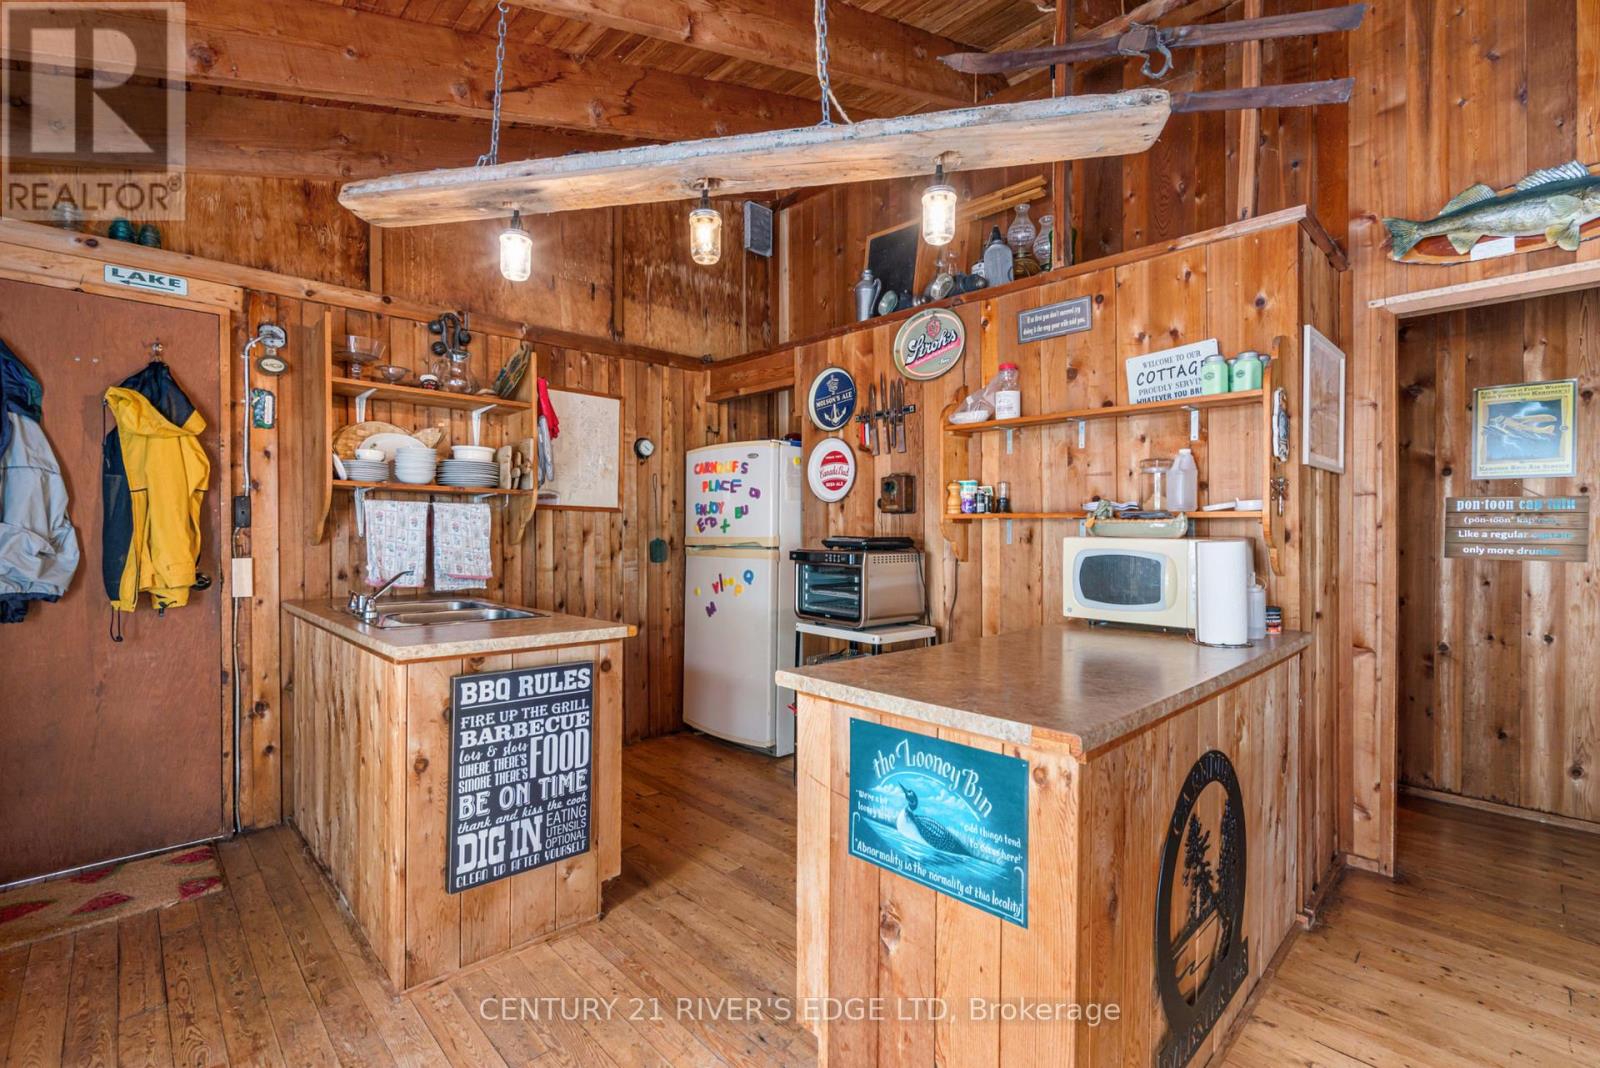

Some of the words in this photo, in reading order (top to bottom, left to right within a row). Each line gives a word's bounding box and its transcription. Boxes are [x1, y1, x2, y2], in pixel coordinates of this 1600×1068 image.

[112, 268, 181, 288] LAKE
[905, 329, 957, 365] Stroh's
[1142, 356, 1173, 368] WELCOME
[1187, 351, 1200, 359] OUR
[816, 395, 841, 408] MOLSON'S
[842, 391, 852, 400] ALE
[1139, 383, 1172, 396] PROUDLY
[1174, 390, 1187, 398] YOU
[702, 478, 742, 493] PLACE
[694, 500, 725, 516] ENJOY
[1458, 529, 1479, 538] Like
[1490, 530, 1529, 541] regular
[1463, 545, 1485, 556] only
[460, 677, 511, 706] BBQ
[518, 668, 591, 698] RULES
[461, 712, 496, 730] FIRE
[500, 709, 519, 723] UP
[521, 704, 548, 720] THE
[551, 698, 590, 714] GRILL
[459, 711, 590, 749] BARBECUE
[487, 745, 498, 758] &
[530, 728, 590, 779] FOOD
[459, 760, 491, 779] WHERE
[493, 754, 528, 772] THERE'S
[872, 749, 896, 779] the
[895, 738, 961, 793] Looney
[961, 768, 993, 818] Bin
[458, 774, 491, 794] SMOKE
[495, 767, 529, 786] THERE'S
[458, 791, 491, 821] BE
[499, 781, 532, 811] ON
[538, 768, 588, 801] TIME
[457, 816, 492, 834] thank
[495, 811, 519, 824] and
[521, 805, 544, 818] kiss
[547, 800, 563, 812] the
[566, 793, 587, 806] cook
[546, 804, 587, 827] EATING
[545, 818, 587, 838] UTENSILS
[979, 826, 1003, 844] things
[1004, 833, 1021, 849] tend
[456, 824, 506, 876] DIG
[510, 814, 544, 861] IN
[545, 830, 587, 850] OPTIONAL
[455, 868, 489, 889] CLEAN
[493, 863, 507, 877] UP
[510, 853, 541, 872] AFTER
[544, 839, 587, 861] YOURSELF
[904, 861, 913, 872] is
[913, 862, 927, 877] the
[929, 871, 965, 896] normality
[974, 887, 991, 902] this
